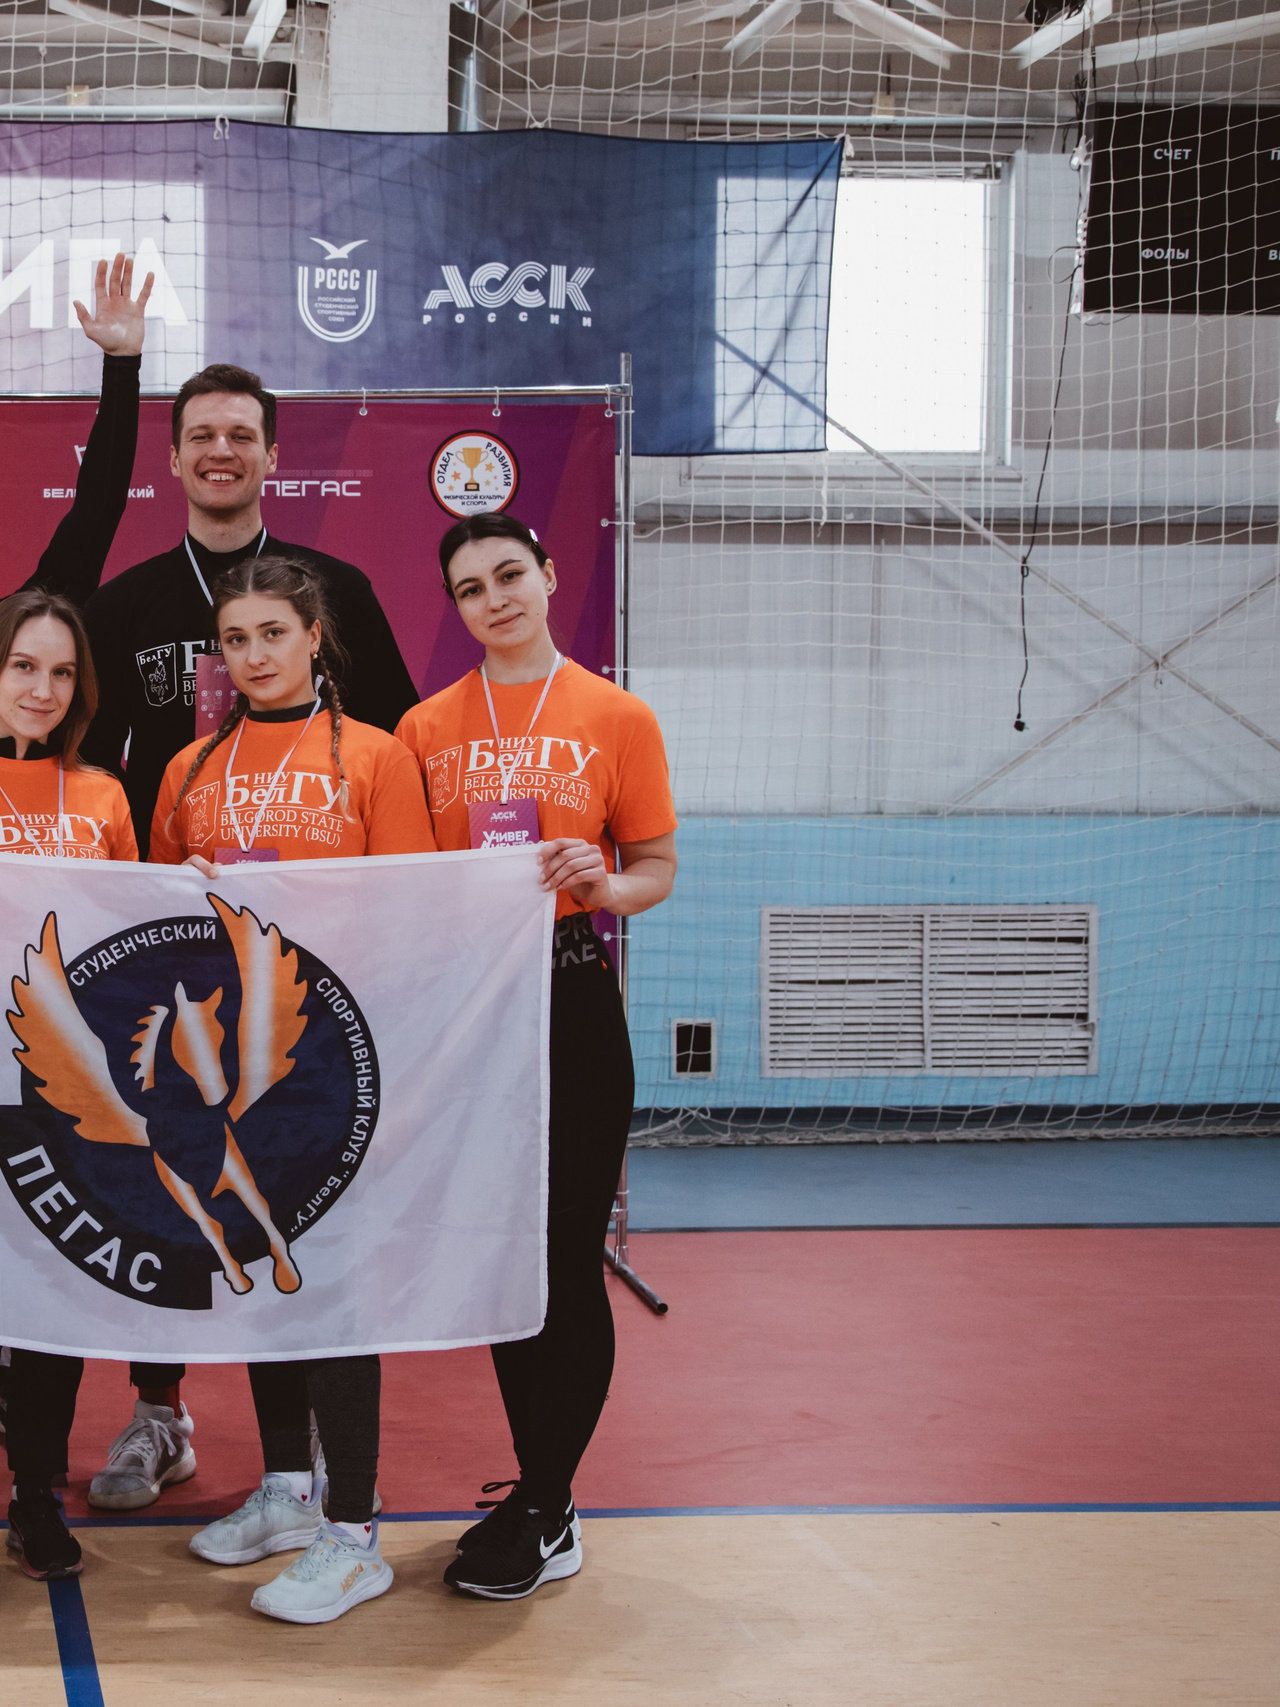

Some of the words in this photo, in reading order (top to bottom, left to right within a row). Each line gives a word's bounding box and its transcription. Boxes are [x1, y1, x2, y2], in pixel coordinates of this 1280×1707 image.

[1153, 148, 1192, 160] СЧЕТ
[1141, 248, 1190, 260] ФОЛЫ
[314, 267, 360, 291] РССС
[423, 261, 595, 312] АССК
[423, 311, 592, 327] РОССИИ
[436, 451, 454, 484] ОТДЕЛ
[485, 442, 512, 487] РАЗВИТИЯ
[261, 480, 361, 497] ПЕГАС
[139, 647, 172, 665] БелГУ
[499, 736, 539, 749] НИУ
[465, 736, 600, 777] БелГУ
[253, 771, 291, 785] НИУ
[550, 776, 591, 799] STATE
[222, 771, 351, 811] БелГУ
[554, 790, 588, 815] (BSU)
[20, 813, 56, 824] НИУ
[301, 811, 344, 832] STATE
[305, 826, 341, 848] (BSU)
[482, 830, 529, 842] УНИВЕР
[69, 920, 216, 986] СТУДЕНЧЕСКИЙ
[316, 977, 376, 1108] СПОРТИВНЫЙ
[341, 1115, 370, 1164] КЛУБ
[6, 1144, 162, 1292] ПЕГАС
